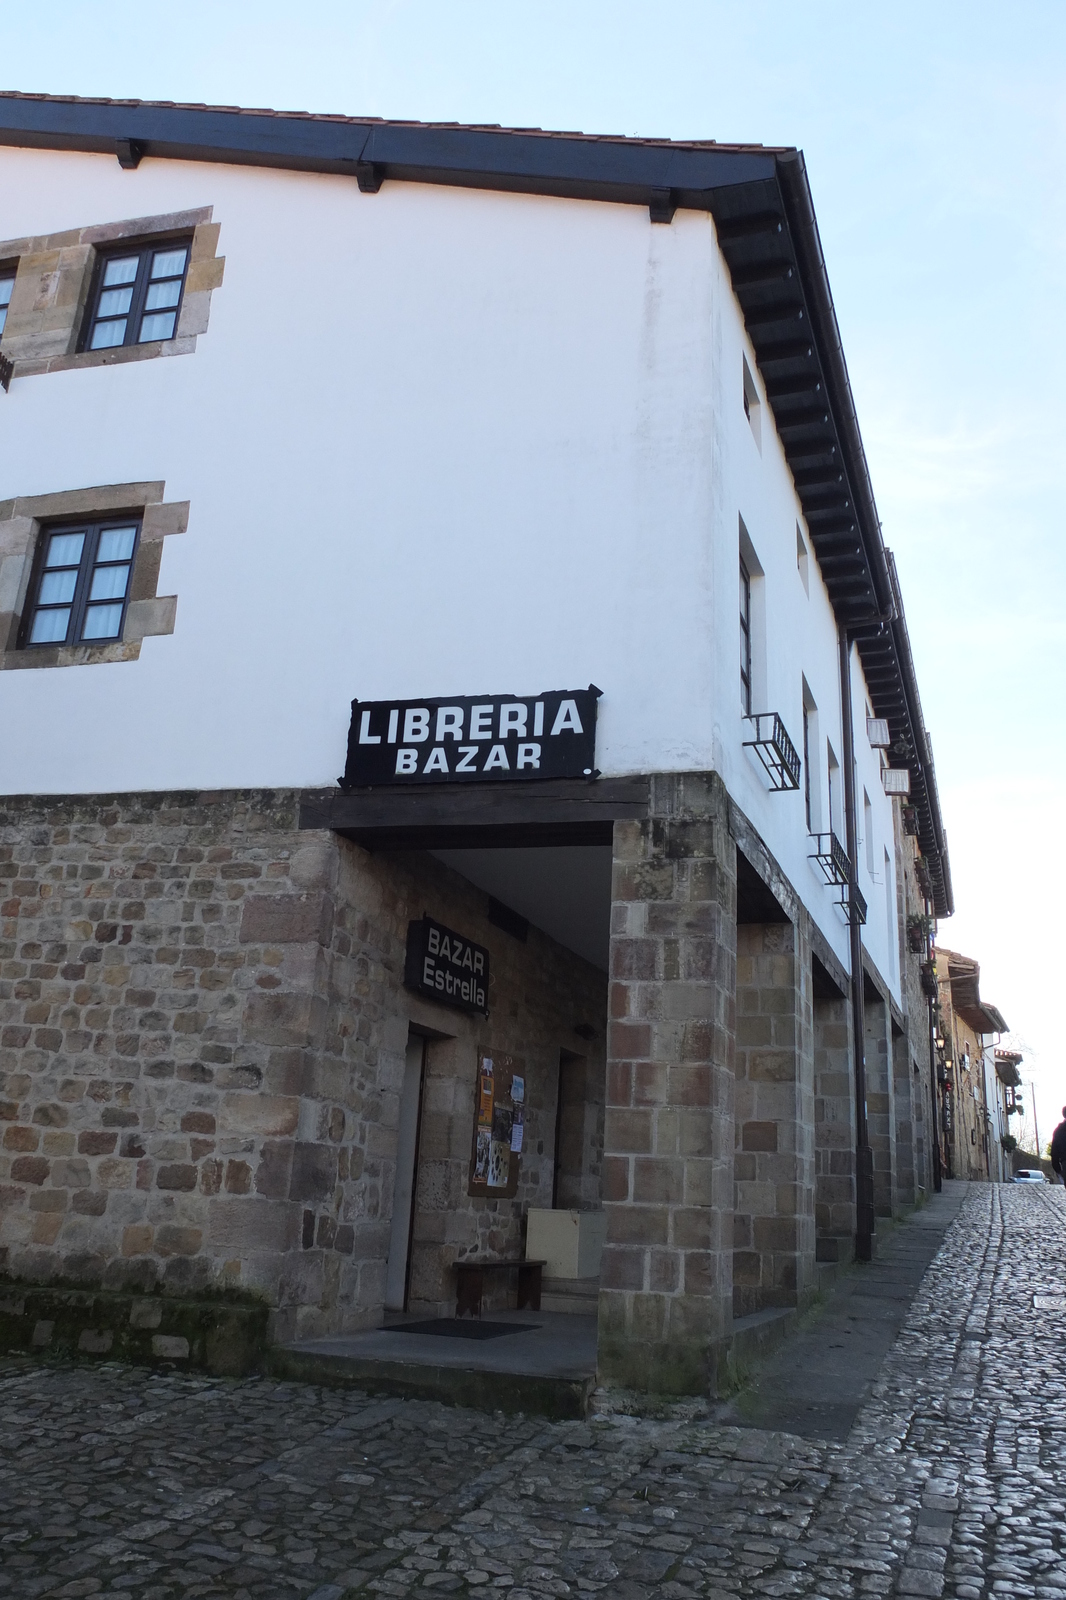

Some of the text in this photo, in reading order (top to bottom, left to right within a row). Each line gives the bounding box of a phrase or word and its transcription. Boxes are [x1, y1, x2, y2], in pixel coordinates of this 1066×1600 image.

[358, 699, 584, 745] LIBRERIA
[394, 742, 542, 775] BAZAR
[428, 927, 484, 977] BAZAR
[423, 956, 485, 1007] Estrella
